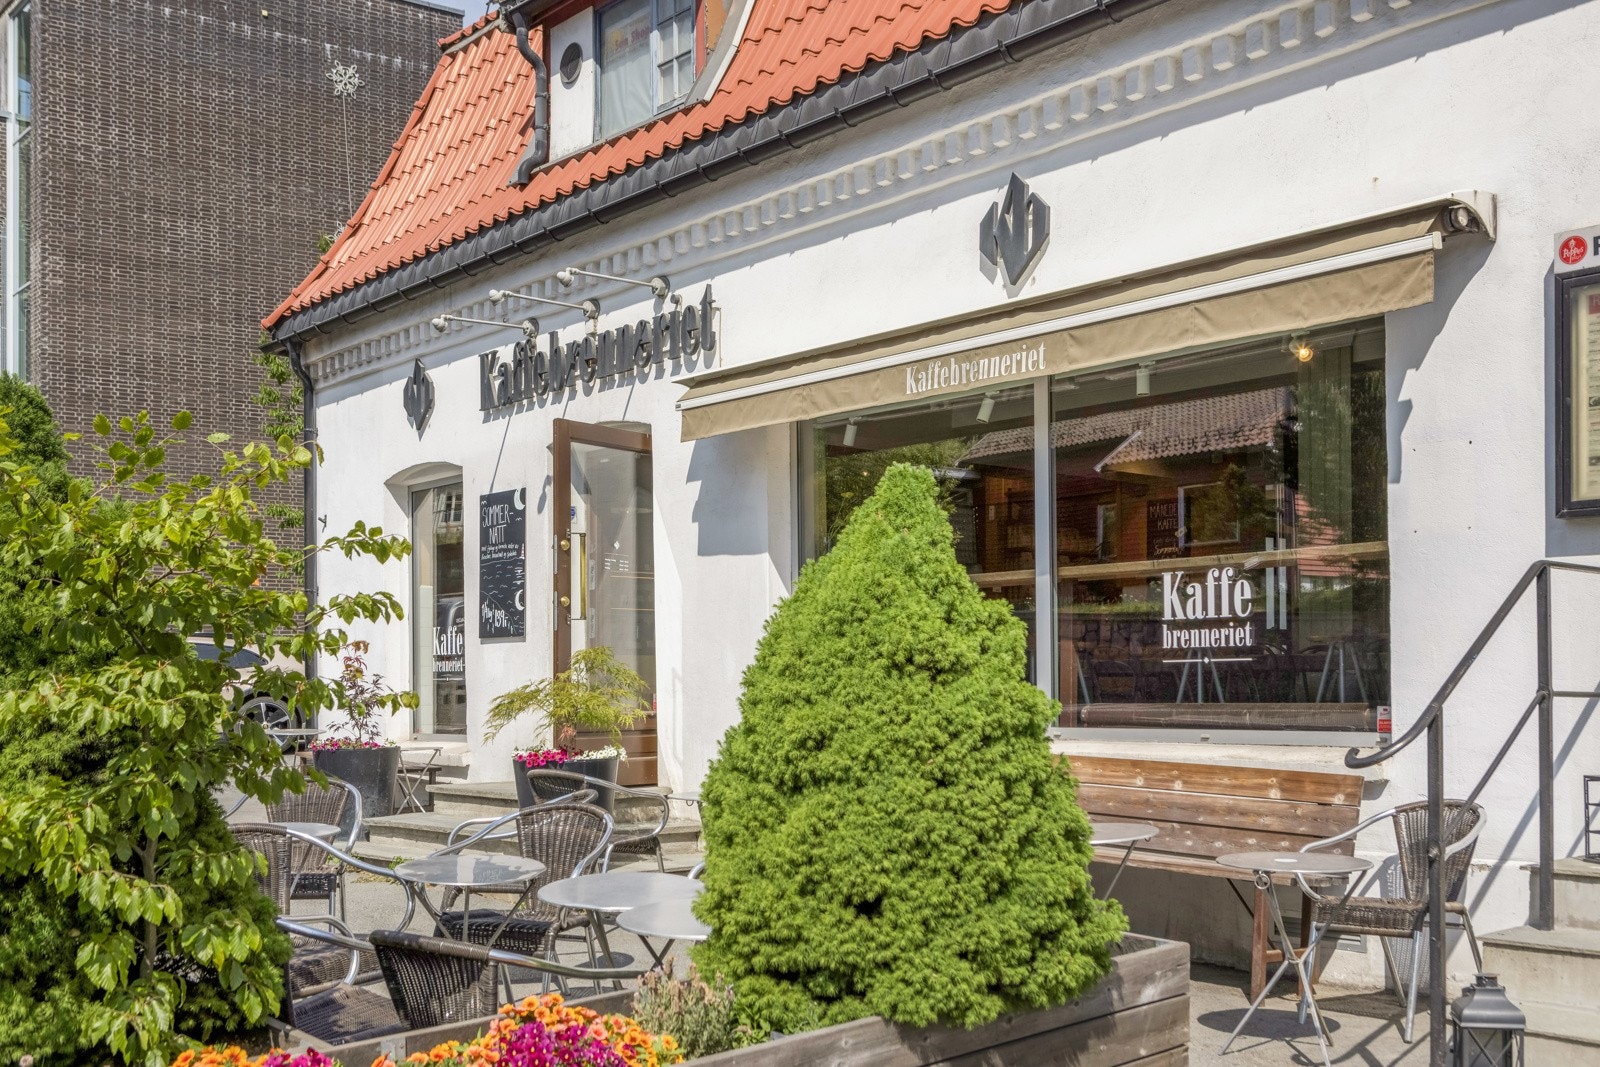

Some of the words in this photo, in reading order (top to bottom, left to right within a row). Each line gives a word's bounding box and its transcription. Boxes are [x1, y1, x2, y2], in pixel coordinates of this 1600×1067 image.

[479, 284, 716, 411] Kaffebrenneriet
[906, 342, 1046, 394] Kaffebrenneriet
[489, 524, 507, 544] NATT
[1161, 566, 1252, 620] Kaffe
[433, 625, 464, 655] Kaffe
[1162, 621, 1253, 649] brenneriet
